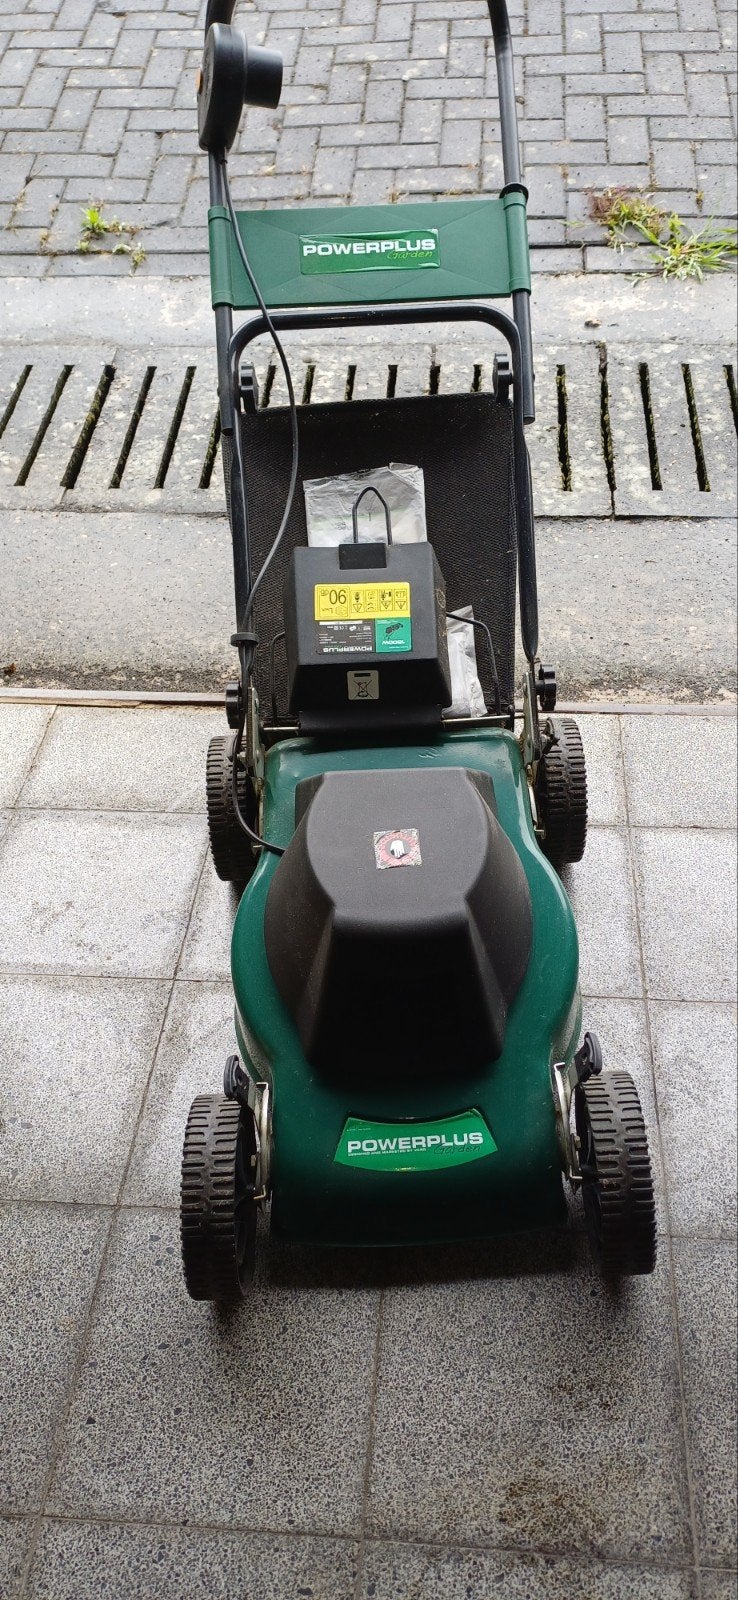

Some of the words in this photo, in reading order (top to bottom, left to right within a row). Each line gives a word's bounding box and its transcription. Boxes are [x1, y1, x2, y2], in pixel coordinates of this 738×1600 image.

[303, 238, 436, 256] POWERPLUS
[387, 250, 433, 260] Garden
[329, 589, 347, 605] 90
[323, 645, 373, 653] POWERPLUS
[347, 1131, 484, 1153] POWERPLUS
[433, 1144, 481, 1155] Garden
